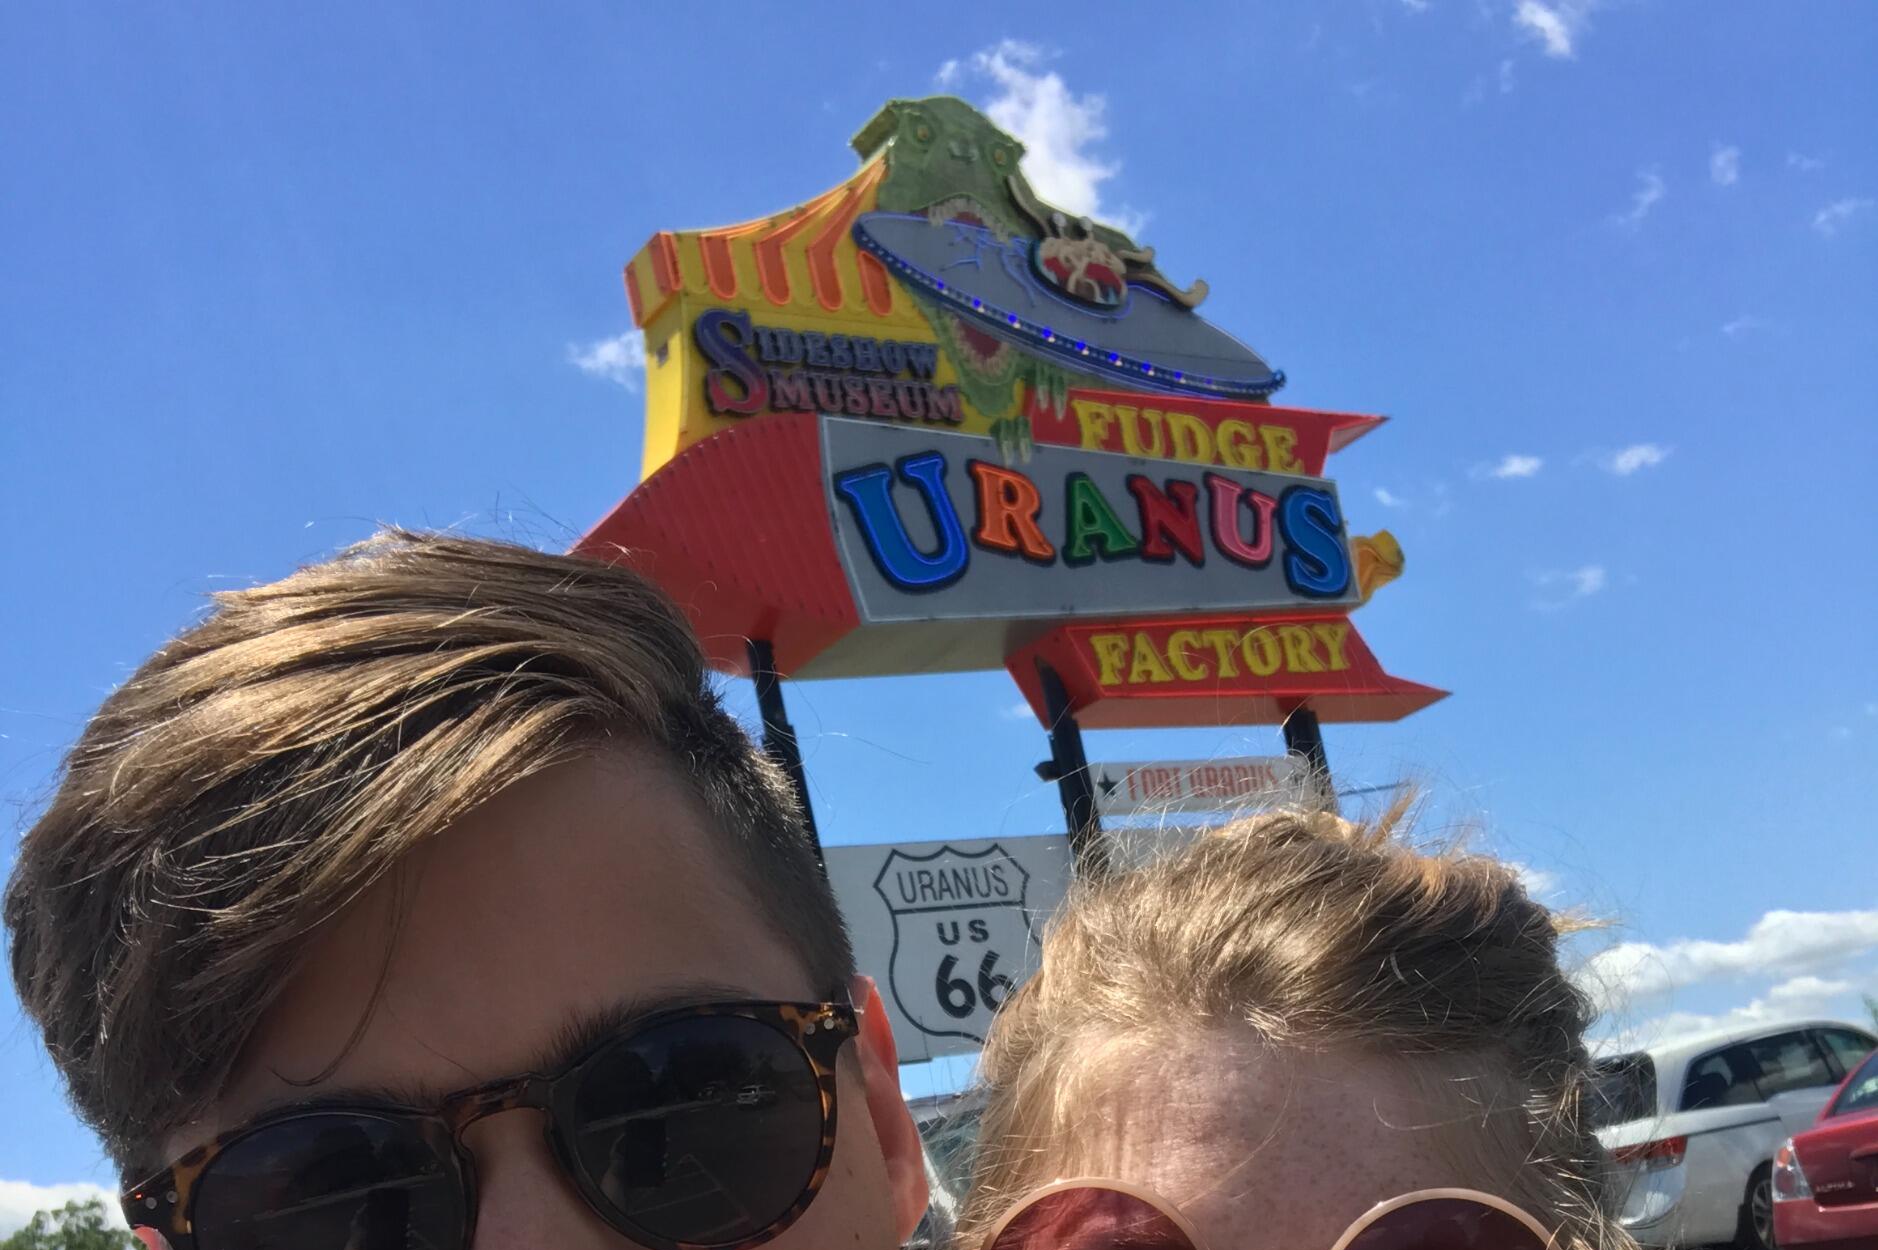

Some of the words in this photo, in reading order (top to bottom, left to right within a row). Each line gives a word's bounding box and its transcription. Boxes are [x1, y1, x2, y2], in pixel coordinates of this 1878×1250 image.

[694, 308, 940, 416] SIDESHOW
[768, 368, 964, 424] MUSEUM
[1072, 399, 1305, 474] FUDGE
[835, 450, 1352, 597] URANUS
[1089, 623, 1352, 686] FACTORY
[897, 864, 1009, 904] URANUS
[936, 919, 990, 946] US
[935, 949, 1017, 1020] 66
